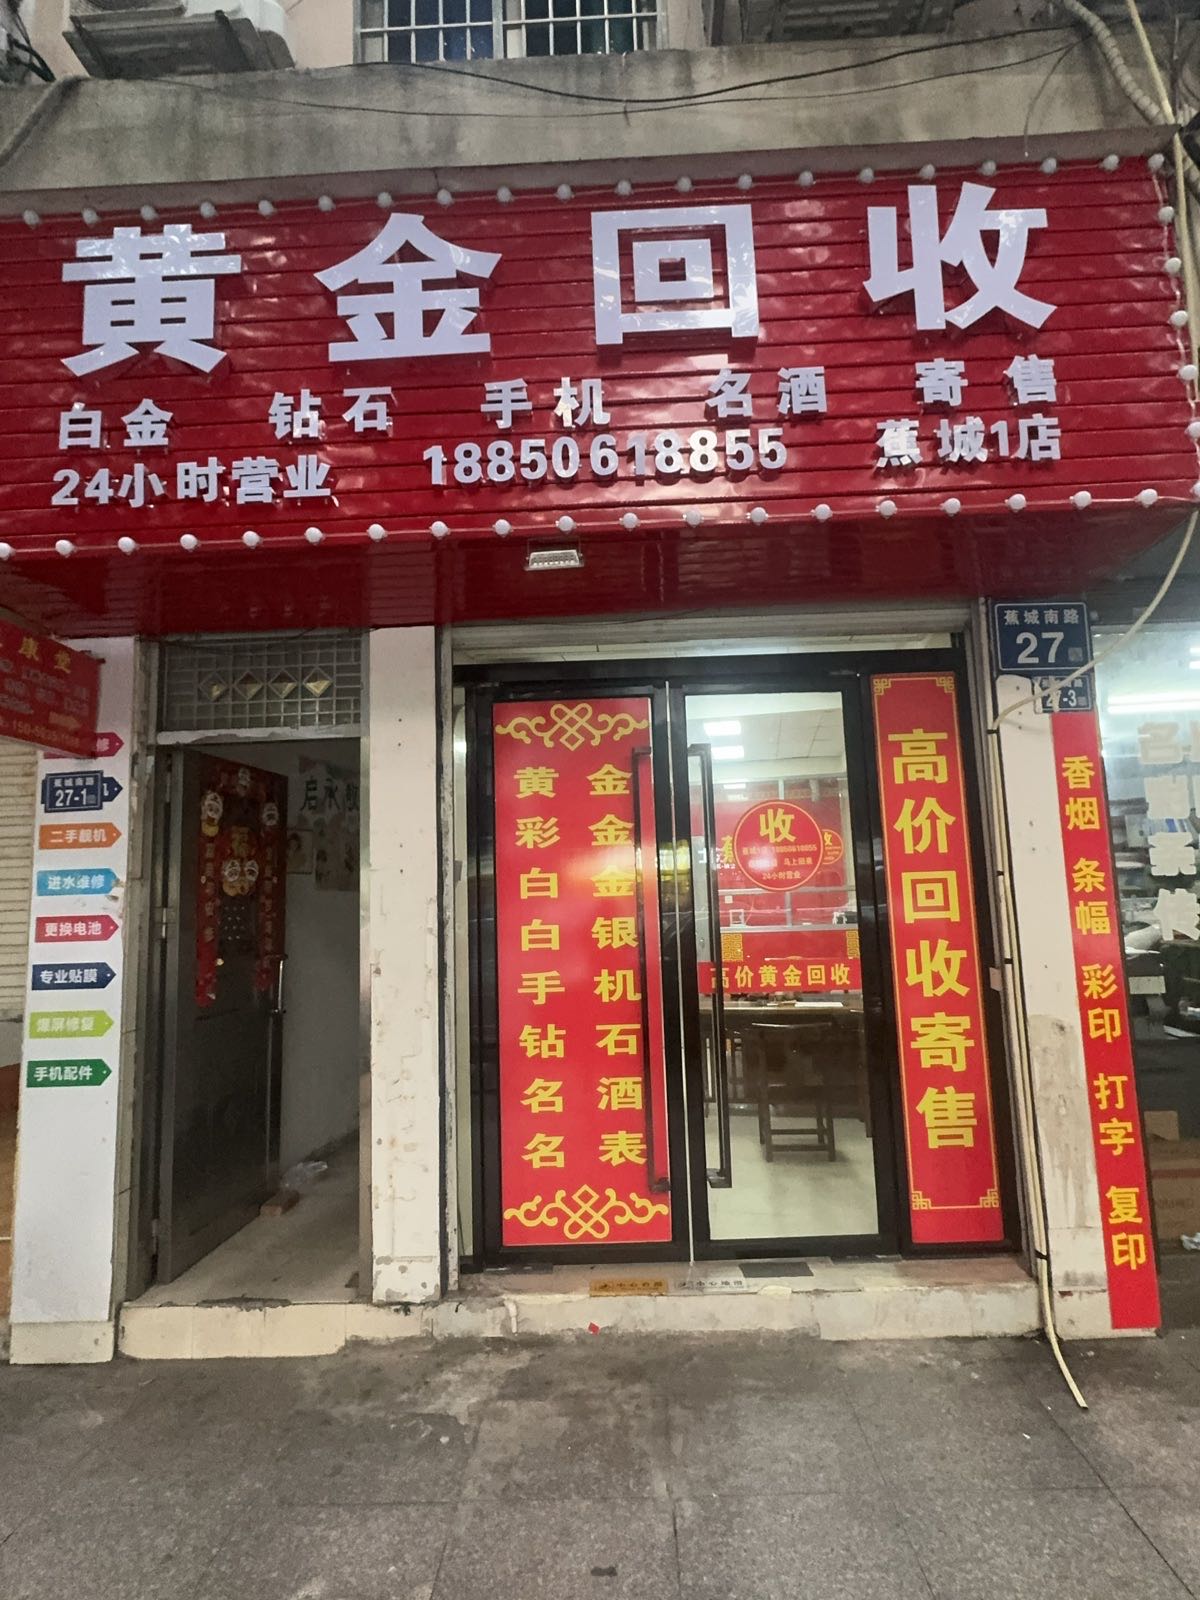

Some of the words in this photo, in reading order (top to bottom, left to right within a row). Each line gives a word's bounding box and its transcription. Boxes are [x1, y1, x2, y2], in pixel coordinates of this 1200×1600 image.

[62, 182, 1057, 377] 黄金回收
[58, 398, 174, 449] 白金
[268, 386, 393, 440] 钻石
[481, 376, 611, 430] 手机
[706, 366, 828, 418] 名酒
[915, 354, 1057, 407] 寄售
[51, 454, 333, 508] 24小时营业
[423, 427, 787, 486] 18850618855
[876, 413, 1062, 468] 蕉城1店
[1004, 608, 1080, 625] 蕉城南路
[1016, 631, 1065, 664] 27
[55, 788, 87, 807] 27-1
[1062, 756, 1100, 830] 香烟
[760, 808, 796, 843] 收
[48, 874, 105, 890] 进水维修
[1072, 858, 1111, 935] 条幅
[44, 920, 102, 937] 更换电池
[888, 728, 977, 1149] 高价回收寄售
[40, 967, 98, 984] 专业贴膜
[710, 963, 851, 988] 高价黄金回收
[1081, 963, 1122, 1043] 彩印
[33, 1064, 93, 1081] 手机配件
[1093, 1073, 1135, 1156] 打字
[1105, 1186, 1147, 1270] 复印
